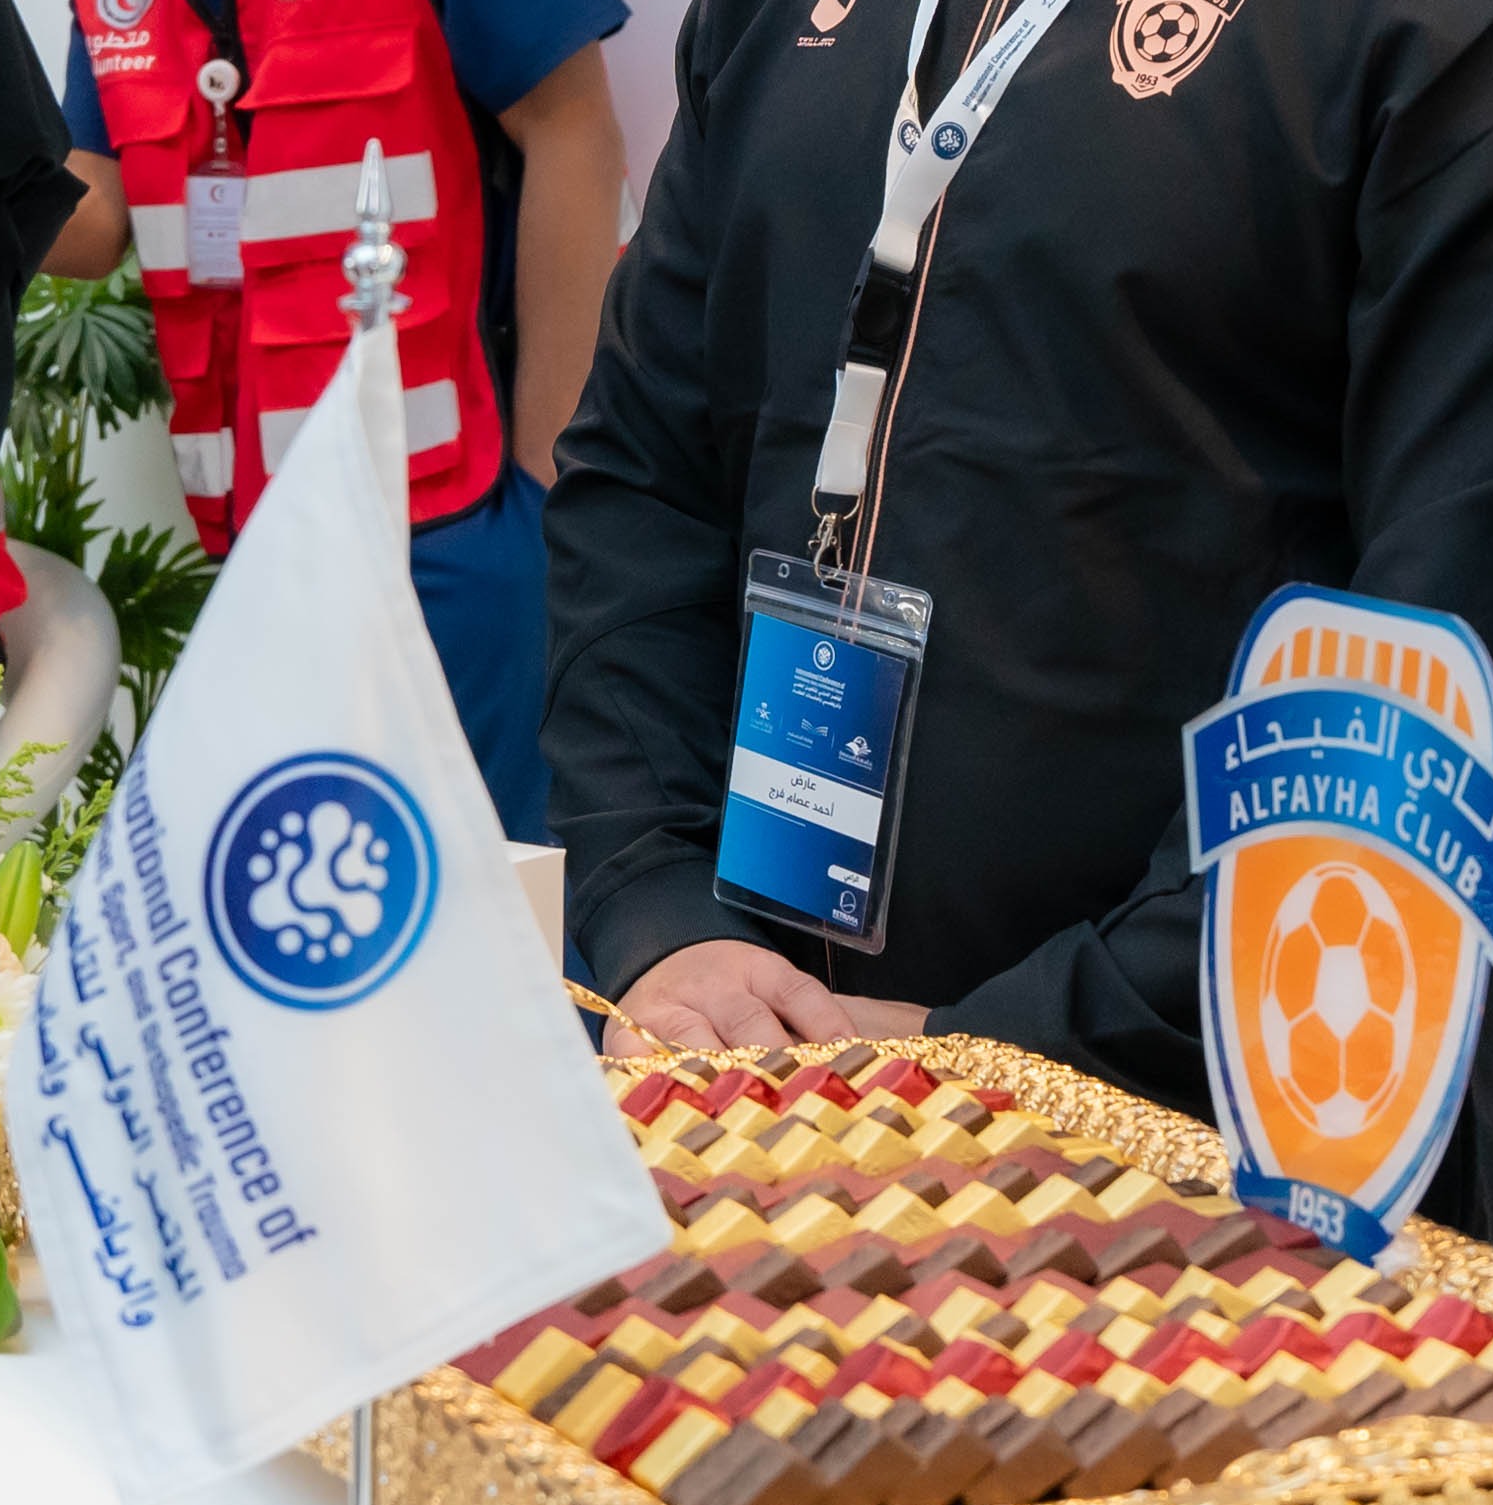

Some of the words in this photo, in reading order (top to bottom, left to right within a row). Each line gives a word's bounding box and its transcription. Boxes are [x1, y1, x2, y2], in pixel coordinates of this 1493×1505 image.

[1135, 72, 1159, 87] 1953
[1224, 703, 1402, 772] الفيحاء
[768, 786, 786, 800] فرج
[785, 793, 811, 808] عصام
[790, 774, 817, 792] عارض
[812, 802, 835, 817] أحمد
[1228, 773, 1381, 832] ALFAYHA
[1394, 799, 1484, 900] CLUB
[157, 946, 282, 1204] Conference
[256, 1205, 319, 1256] of
[41, 1113, 159, 1328] والرياضي
[186, 1170, 249, 1283] Trauma
[1288, 1182, 1346, 1245] 1953
